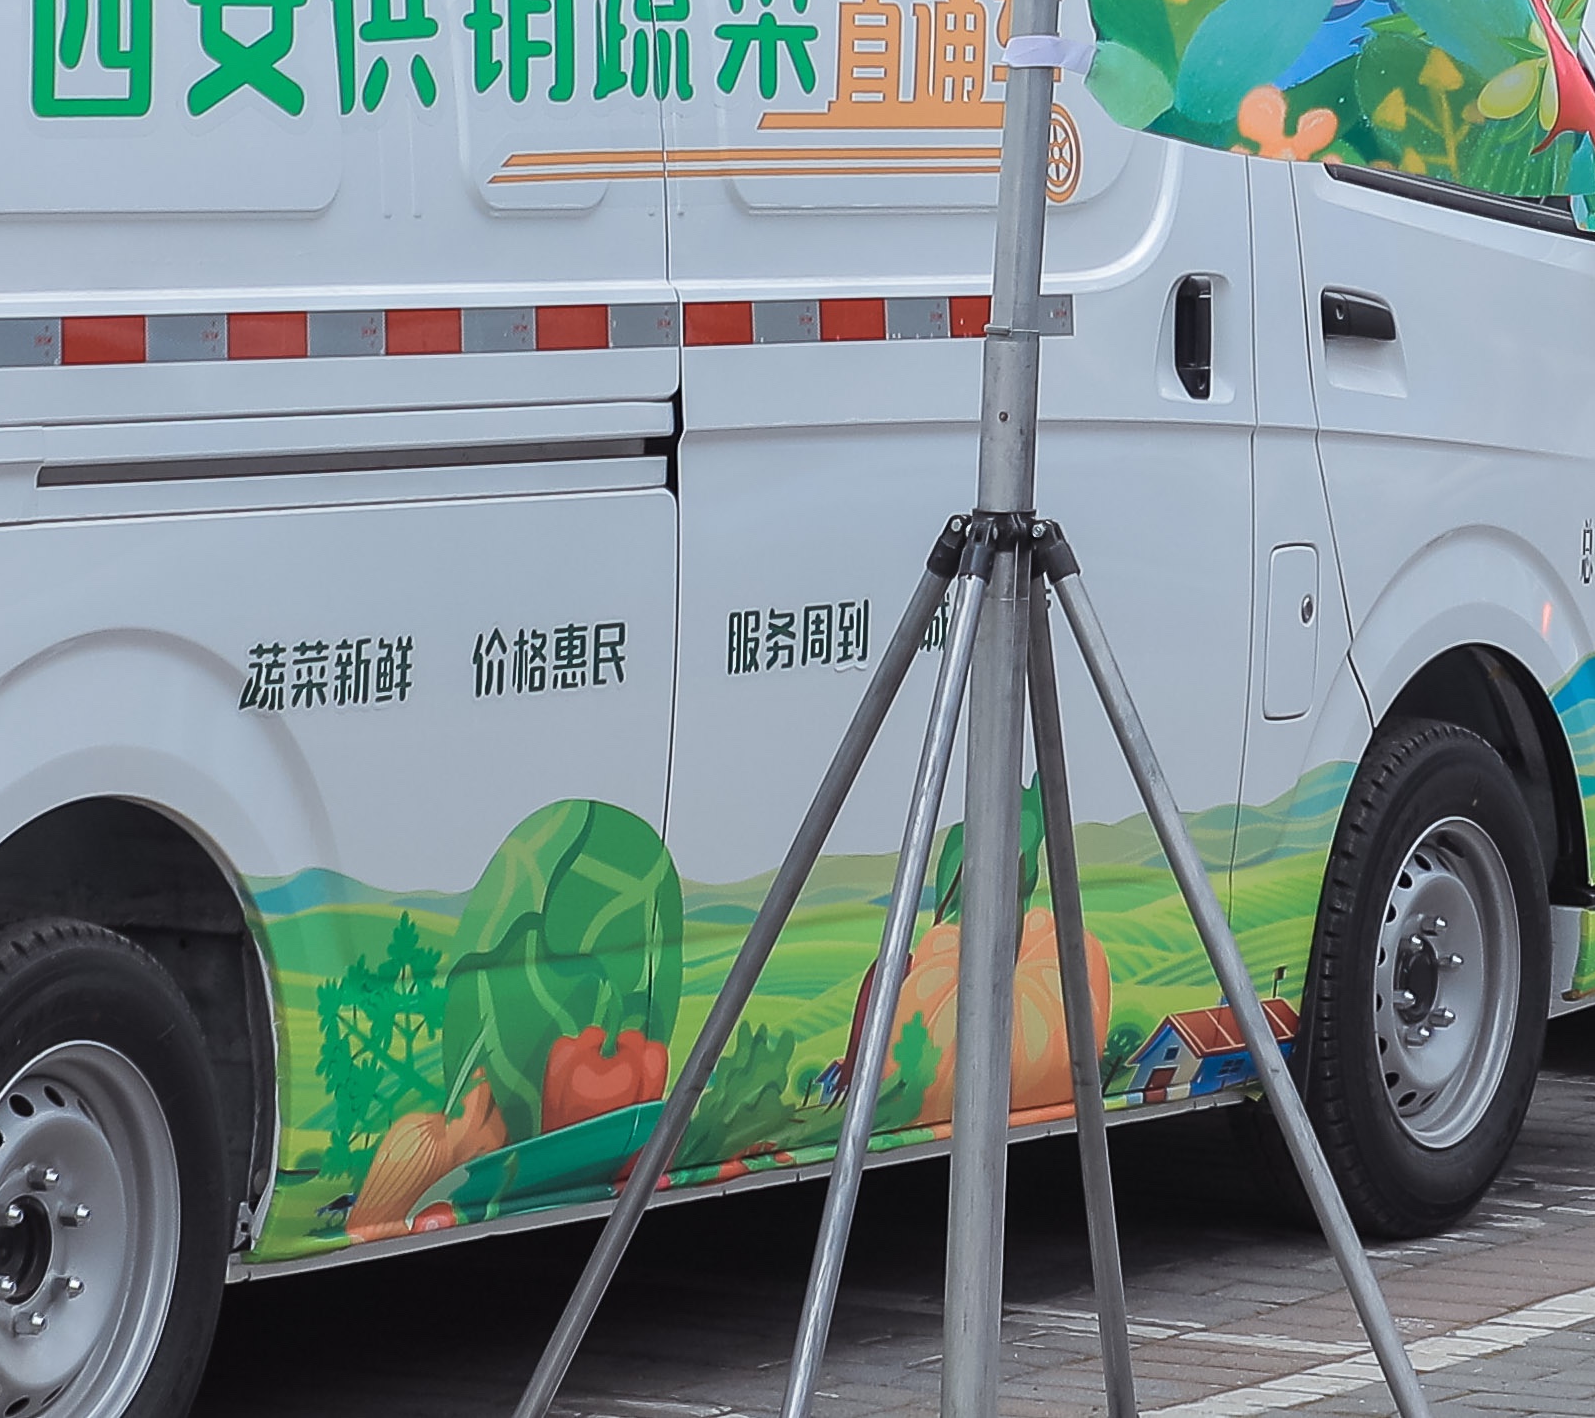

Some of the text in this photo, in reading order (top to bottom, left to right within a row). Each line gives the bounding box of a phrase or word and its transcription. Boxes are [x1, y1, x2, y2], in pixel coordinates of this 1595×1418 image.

[238, 635, 415, 713] 蔬菜新鲜
[472, 621, 627, 699] 价格惠民
[728, 598, 869, 674] 服务周到
